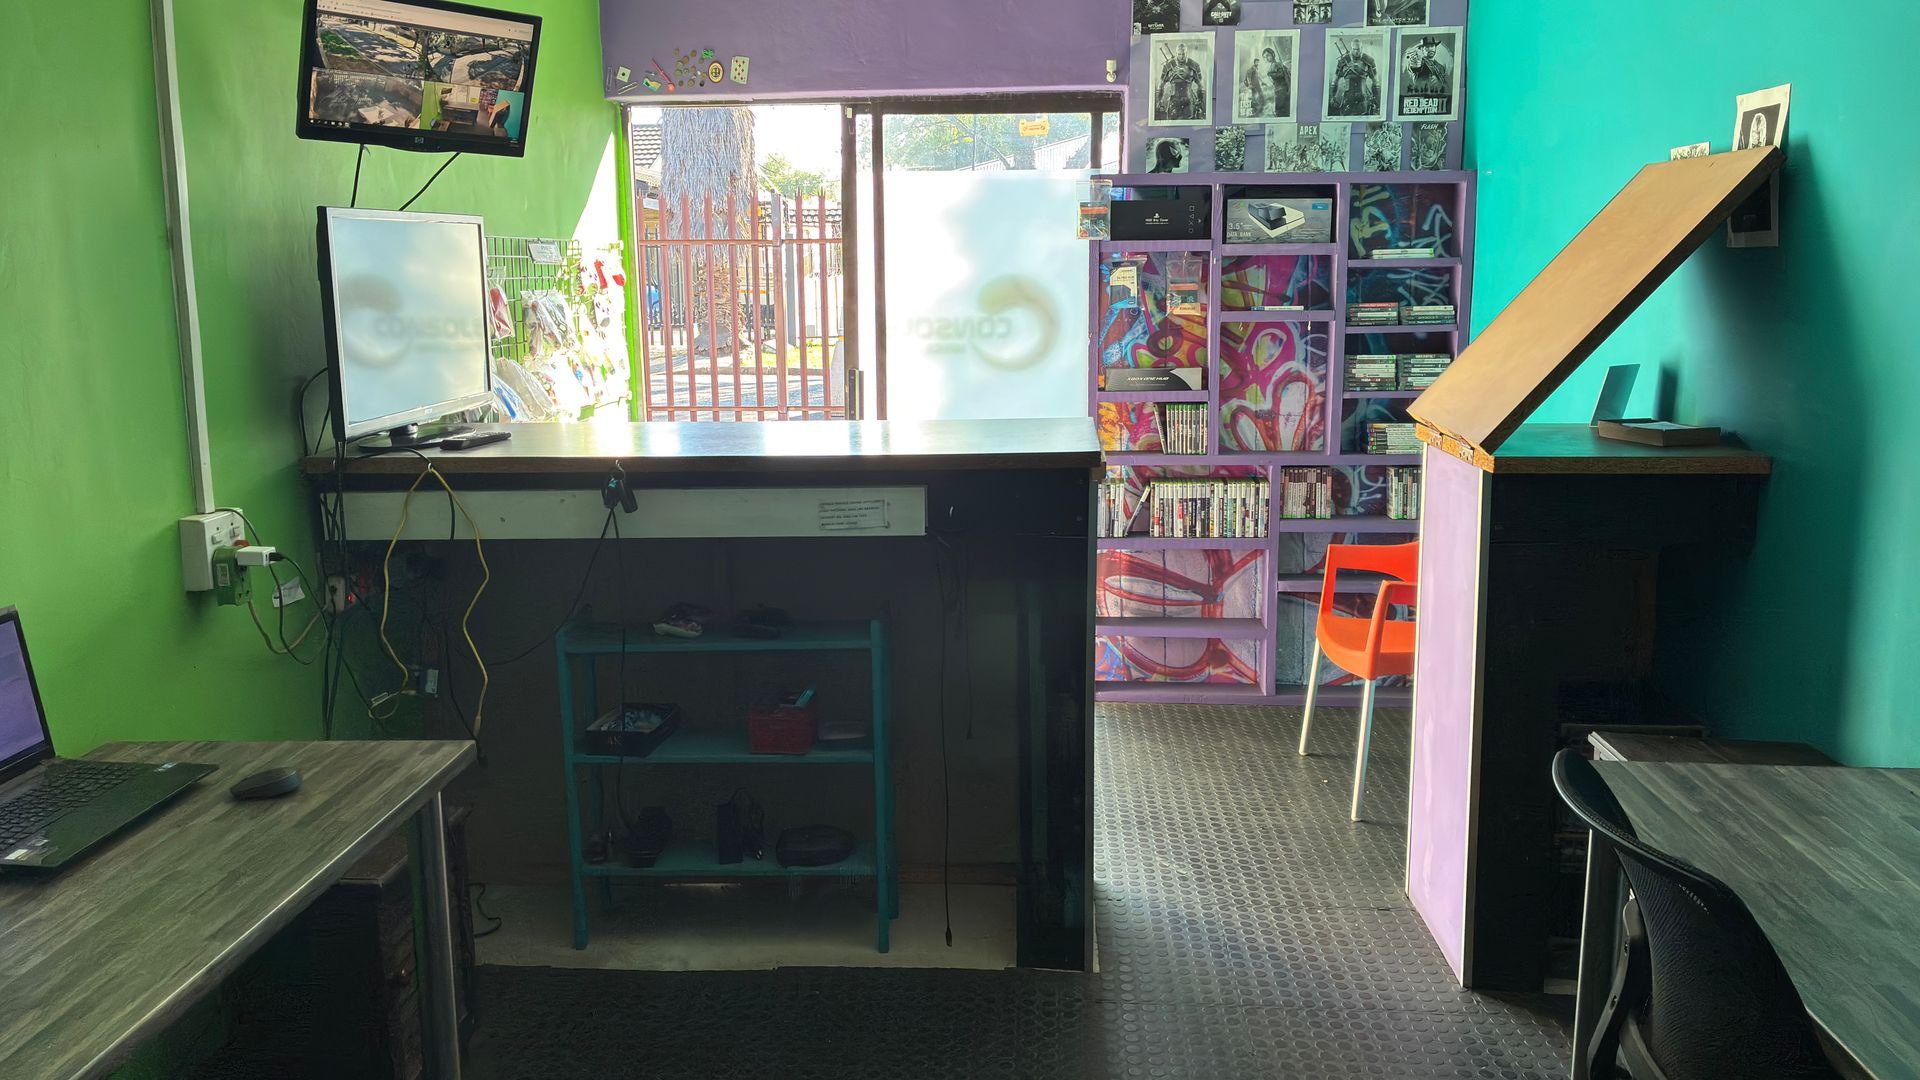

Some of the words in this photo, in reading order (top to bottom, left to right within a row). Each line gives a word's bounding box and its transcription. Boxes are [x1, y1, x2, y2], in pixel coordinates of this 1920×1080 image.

[1404, 98, 1419, 107] RED
[1420, 98, 1439, 107] DEAD
[1300, 126, 1317, 135] APEX
